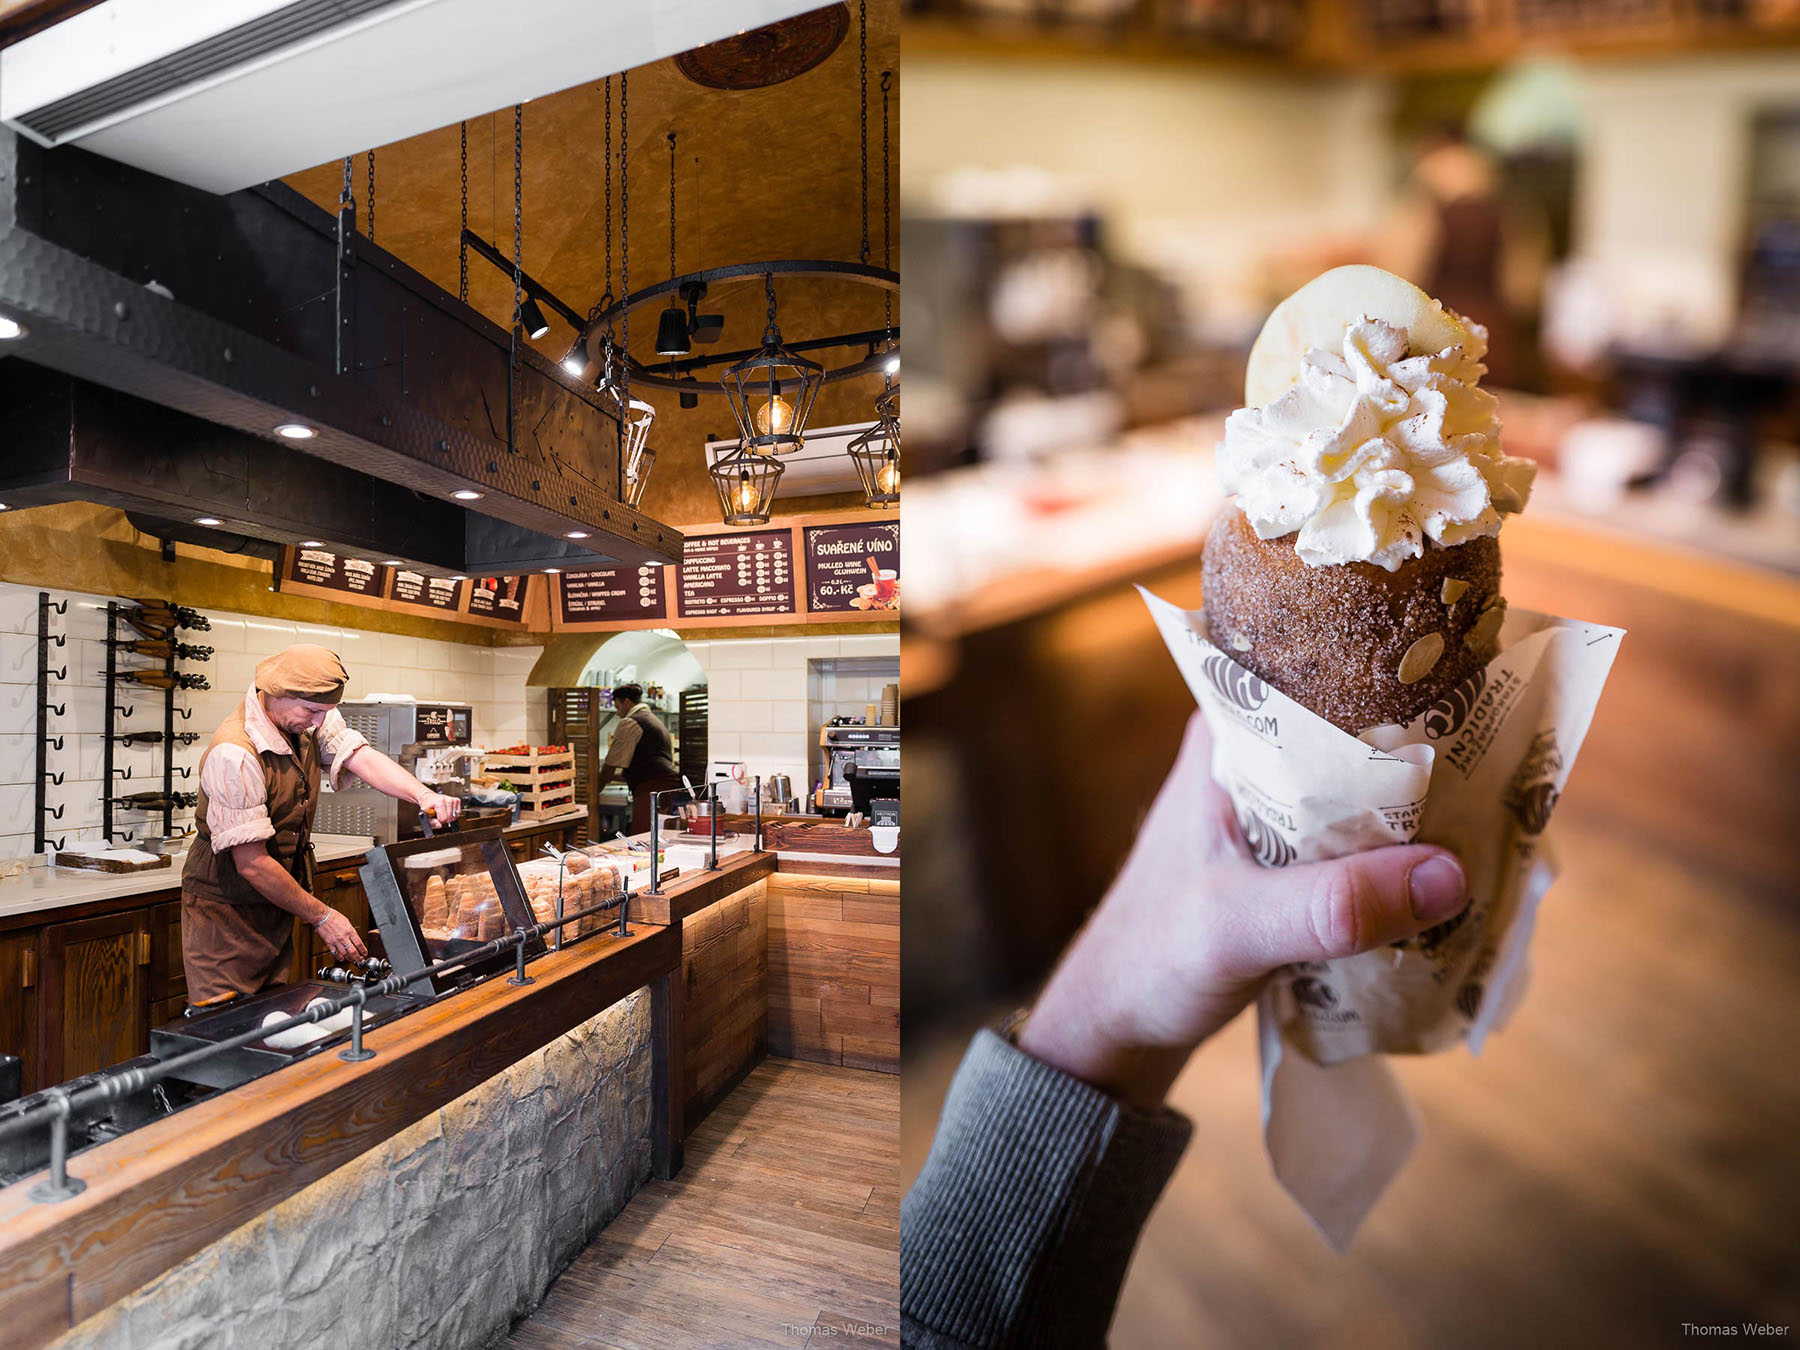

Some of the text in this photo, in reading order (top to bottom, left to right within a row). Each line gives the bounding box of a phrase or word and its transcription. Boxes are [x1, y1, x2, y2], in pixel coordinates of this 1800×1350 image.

[817, 538, 892, 555] SVAŘENÉ VÍNO
[1384, 807, 1424, 819] STAR
[1386, 820, 1421, 830] TR
